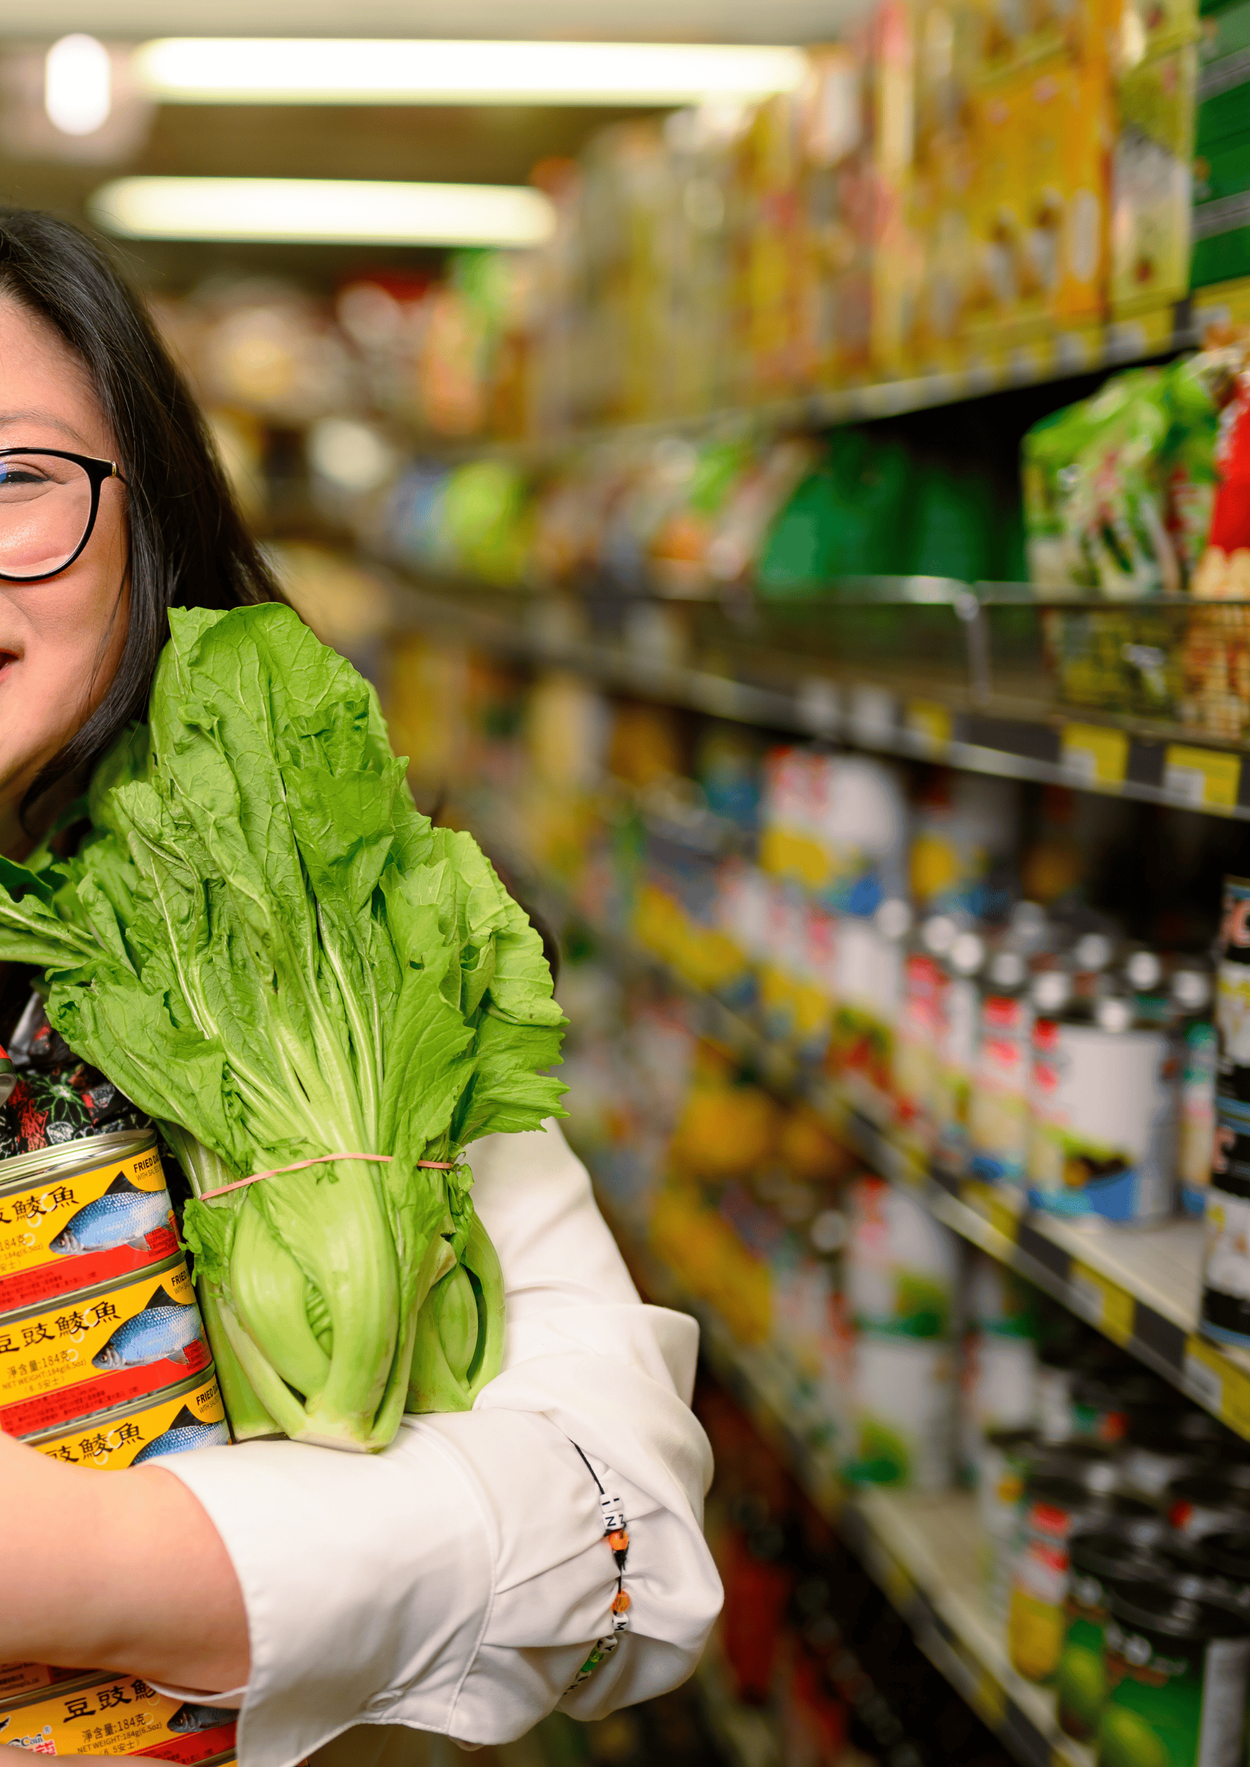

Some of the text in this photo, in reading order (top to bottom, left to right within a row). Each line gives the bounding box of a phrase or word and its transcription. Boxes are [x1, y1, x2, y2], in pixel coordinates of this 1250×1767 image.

[133, 1156, 152, 1173] FRIED
[2, 1380, 17, 1391] NET
[196, 1391, 213, 1406] FRIED
[45, 1422, 146, 1463] 豉鯪魚
[63, 1678, 157, 1724] 豆豉鯪
[82, 1713, 146, 1741] 淨含量:184克
[21, 1732, 44, 1748] Coin
[77, 1745, 91, 1755] NET
